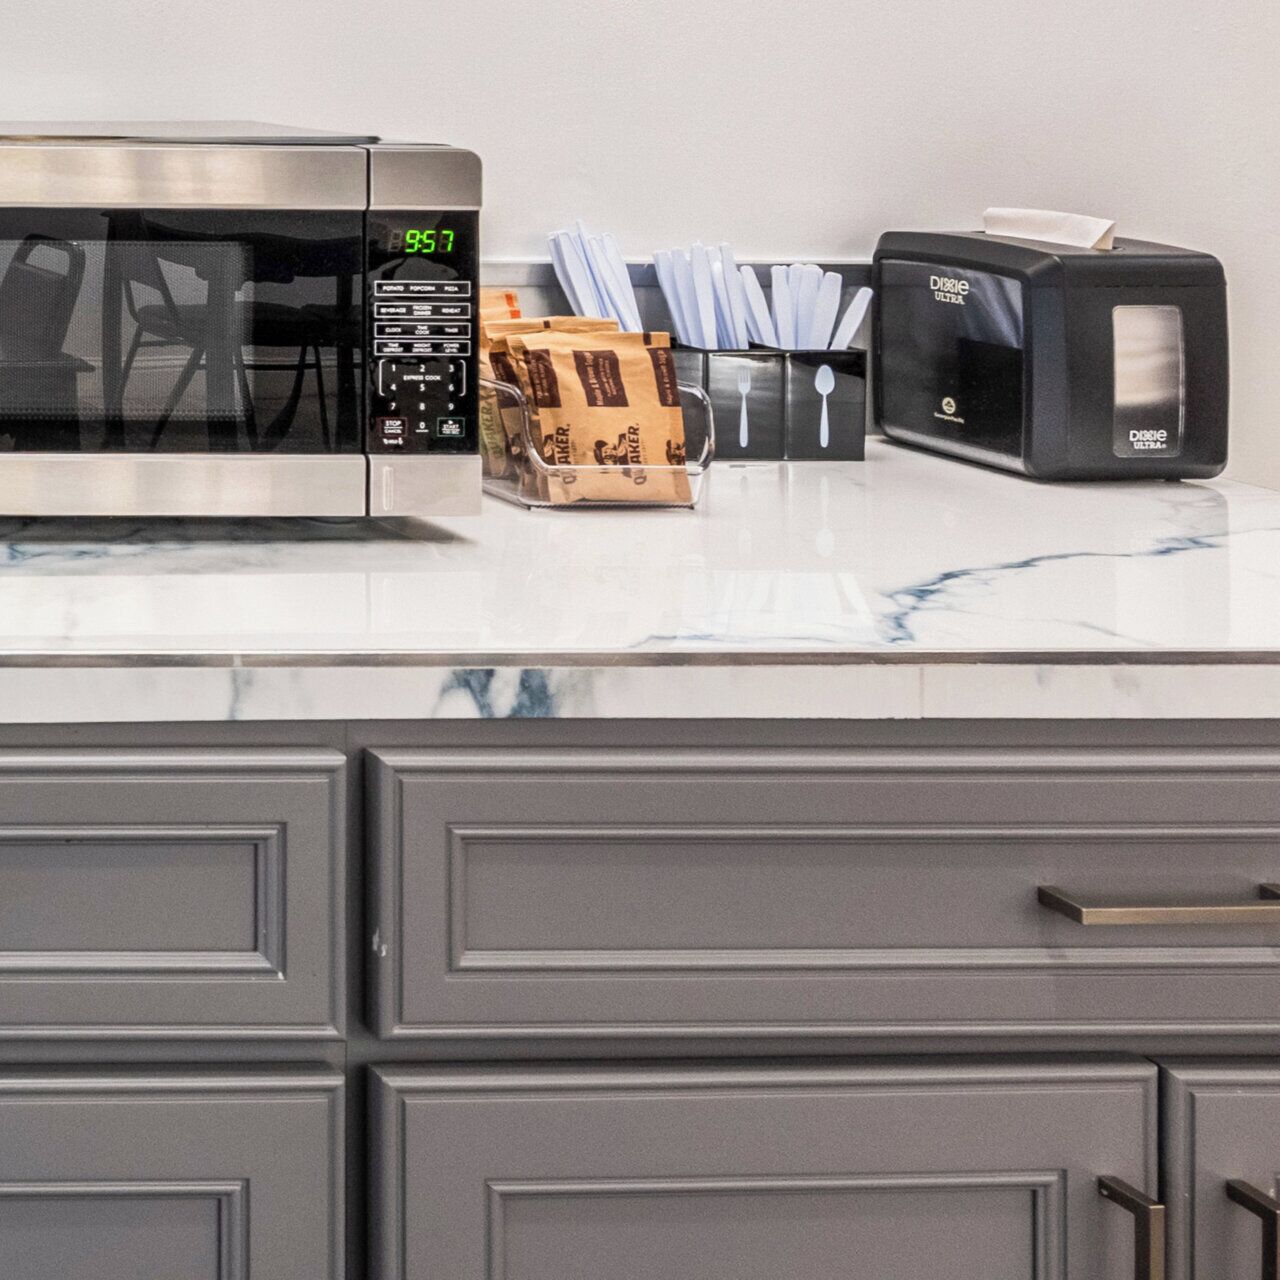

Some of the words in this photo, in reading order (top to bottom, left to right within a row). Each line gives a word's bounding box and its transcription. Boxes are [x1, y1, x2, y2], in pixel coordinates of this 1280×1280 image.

[404, 229, 454, 252] 9:57
[934, 291, 966, 305] ULTRA
[583, 350, 595, 366] Sugar
[391, 364, 396, 372] 1
[420, 364, 426, 372] 2
[449, 364, 455, 372] 3
[586, 366, 598, 384] Brown
[390, 383, 397, 391] 4
[420, 383, 426, 391] 5
[593, 388, 605, 406] Maple
[390, 402, 396, 410] 7
[420, 402, 426, 410] 8
[448, 402, 455, 410] 9
[420, 421, 426, 429] 0
[1133, 441, 1162, 449] ULTRA
